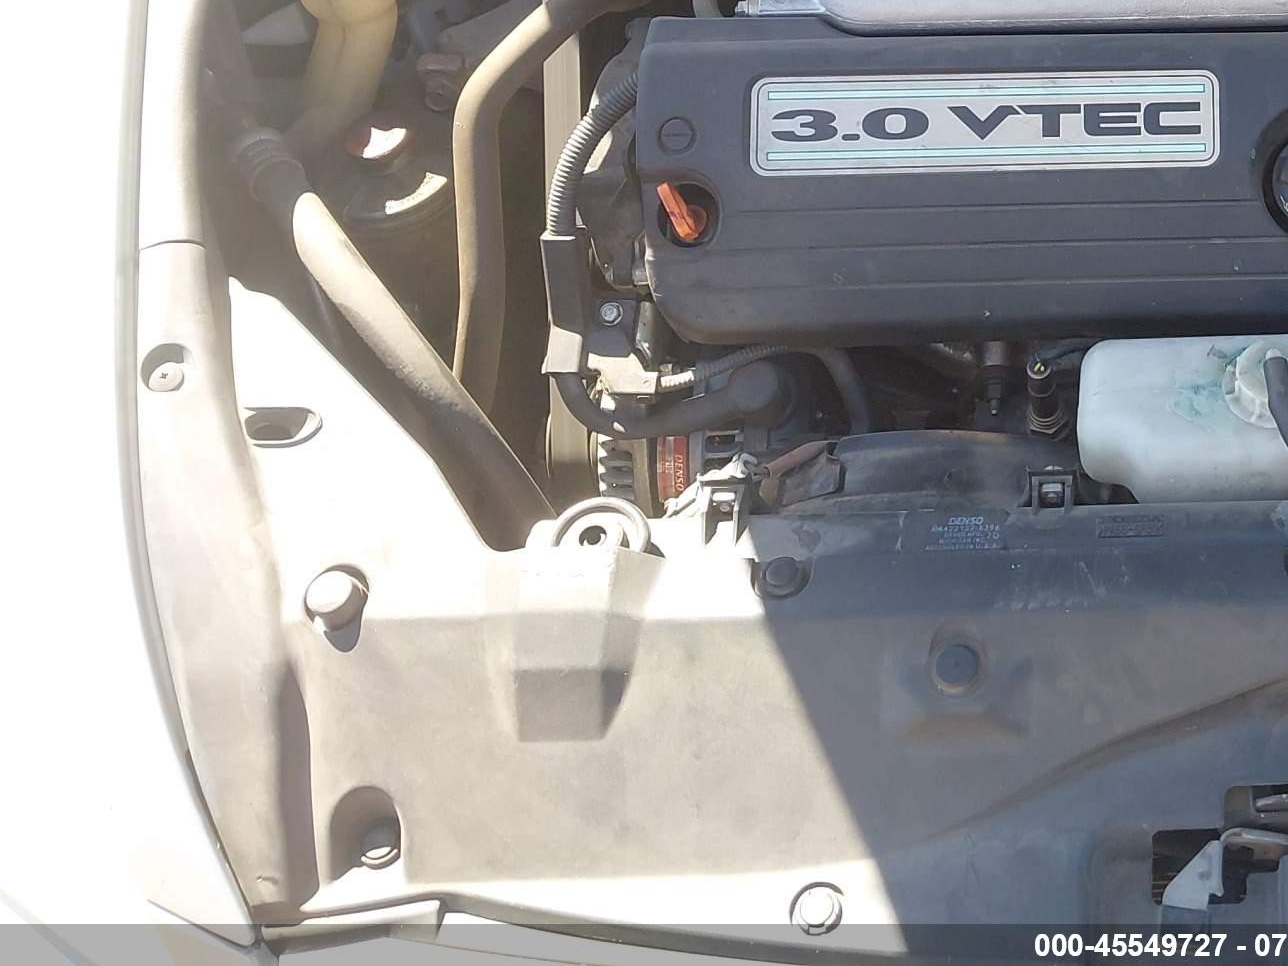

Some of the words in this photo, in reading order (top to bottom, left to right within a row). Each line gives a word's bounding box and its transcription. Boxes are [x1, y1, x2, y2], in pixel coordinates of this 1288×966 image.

[771, 107, 929, 142] 3.0
[946, 101, 1201, 141] VTEC
[675, 454, 685, 491] DENSO
[948, 516, 984, 525] DENSO
